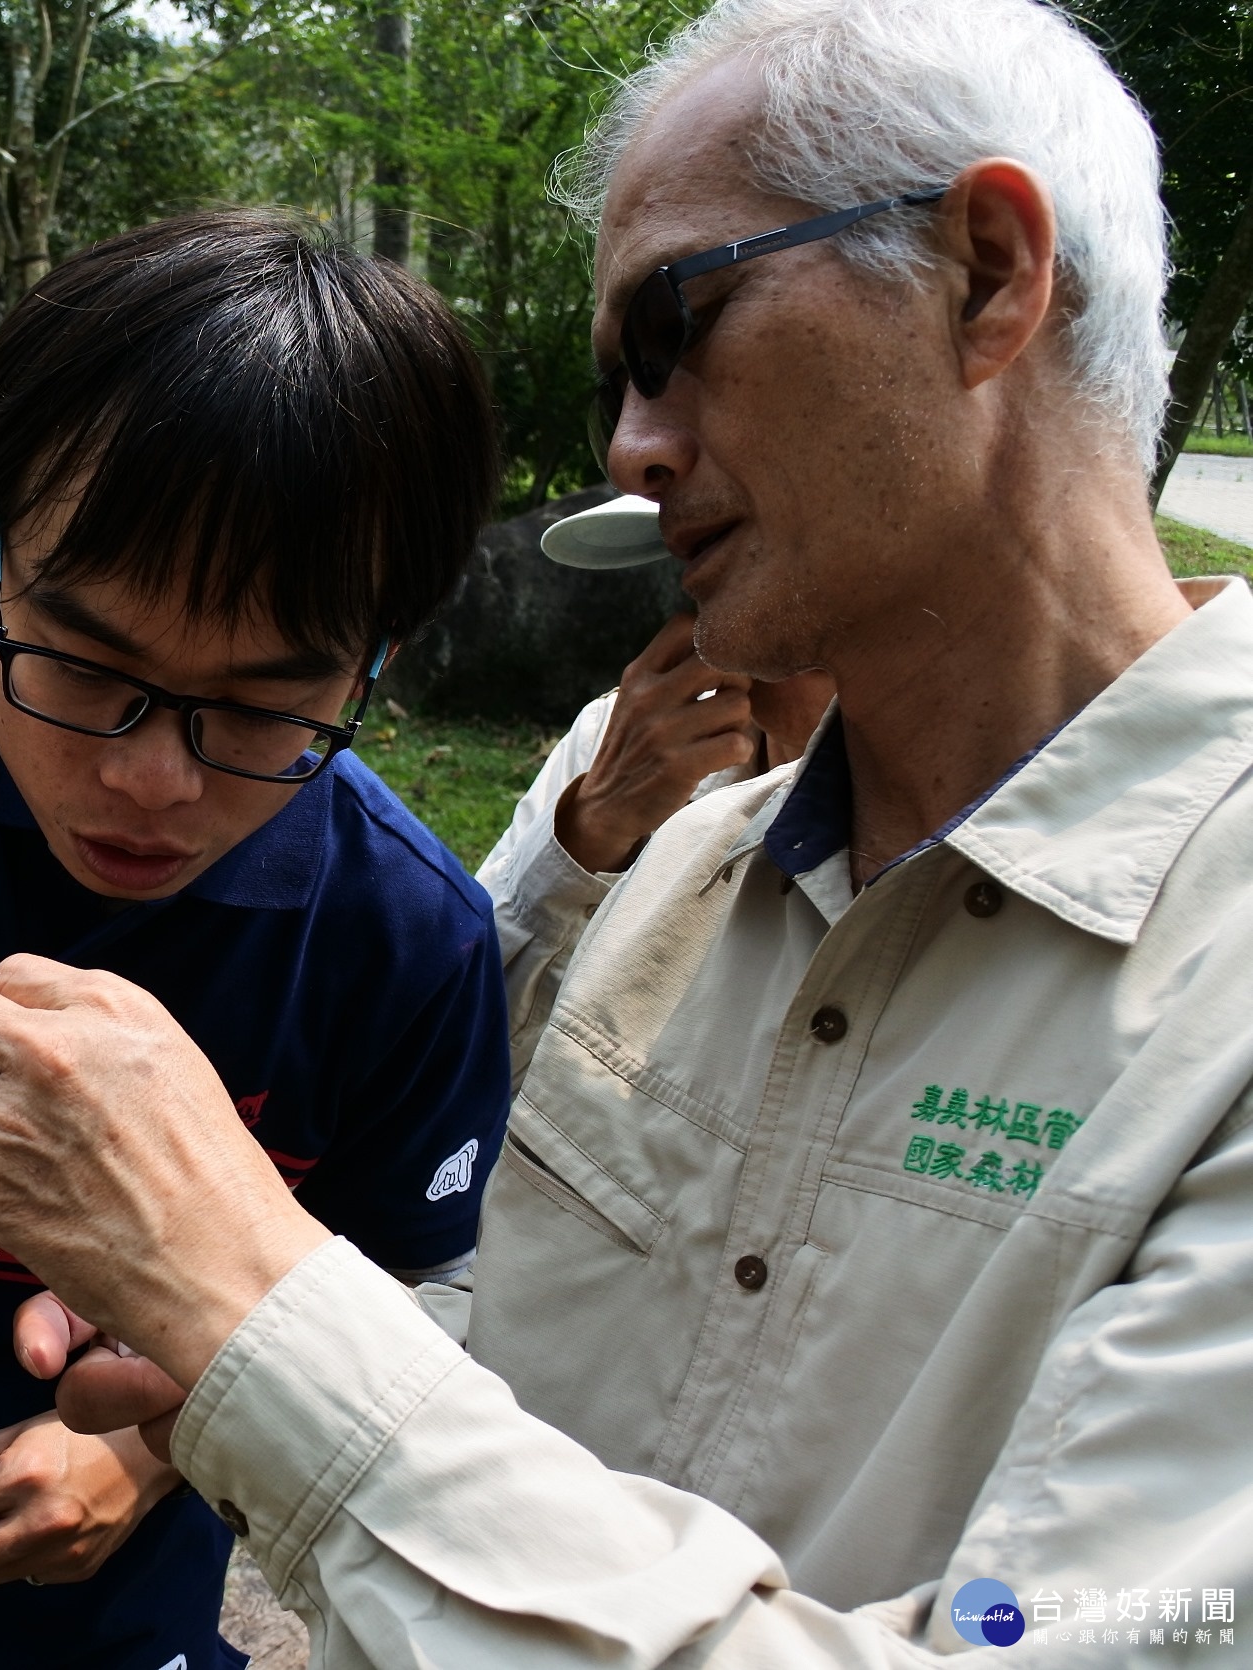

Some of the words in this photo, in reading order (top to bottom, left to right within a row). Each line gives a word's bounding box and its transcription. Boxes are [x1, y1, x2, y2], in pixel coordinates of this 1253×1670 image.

[911, 1084, 1084, 1149] 嘉義林區管
[903, 1135, 1045, 1201] 國家森林
